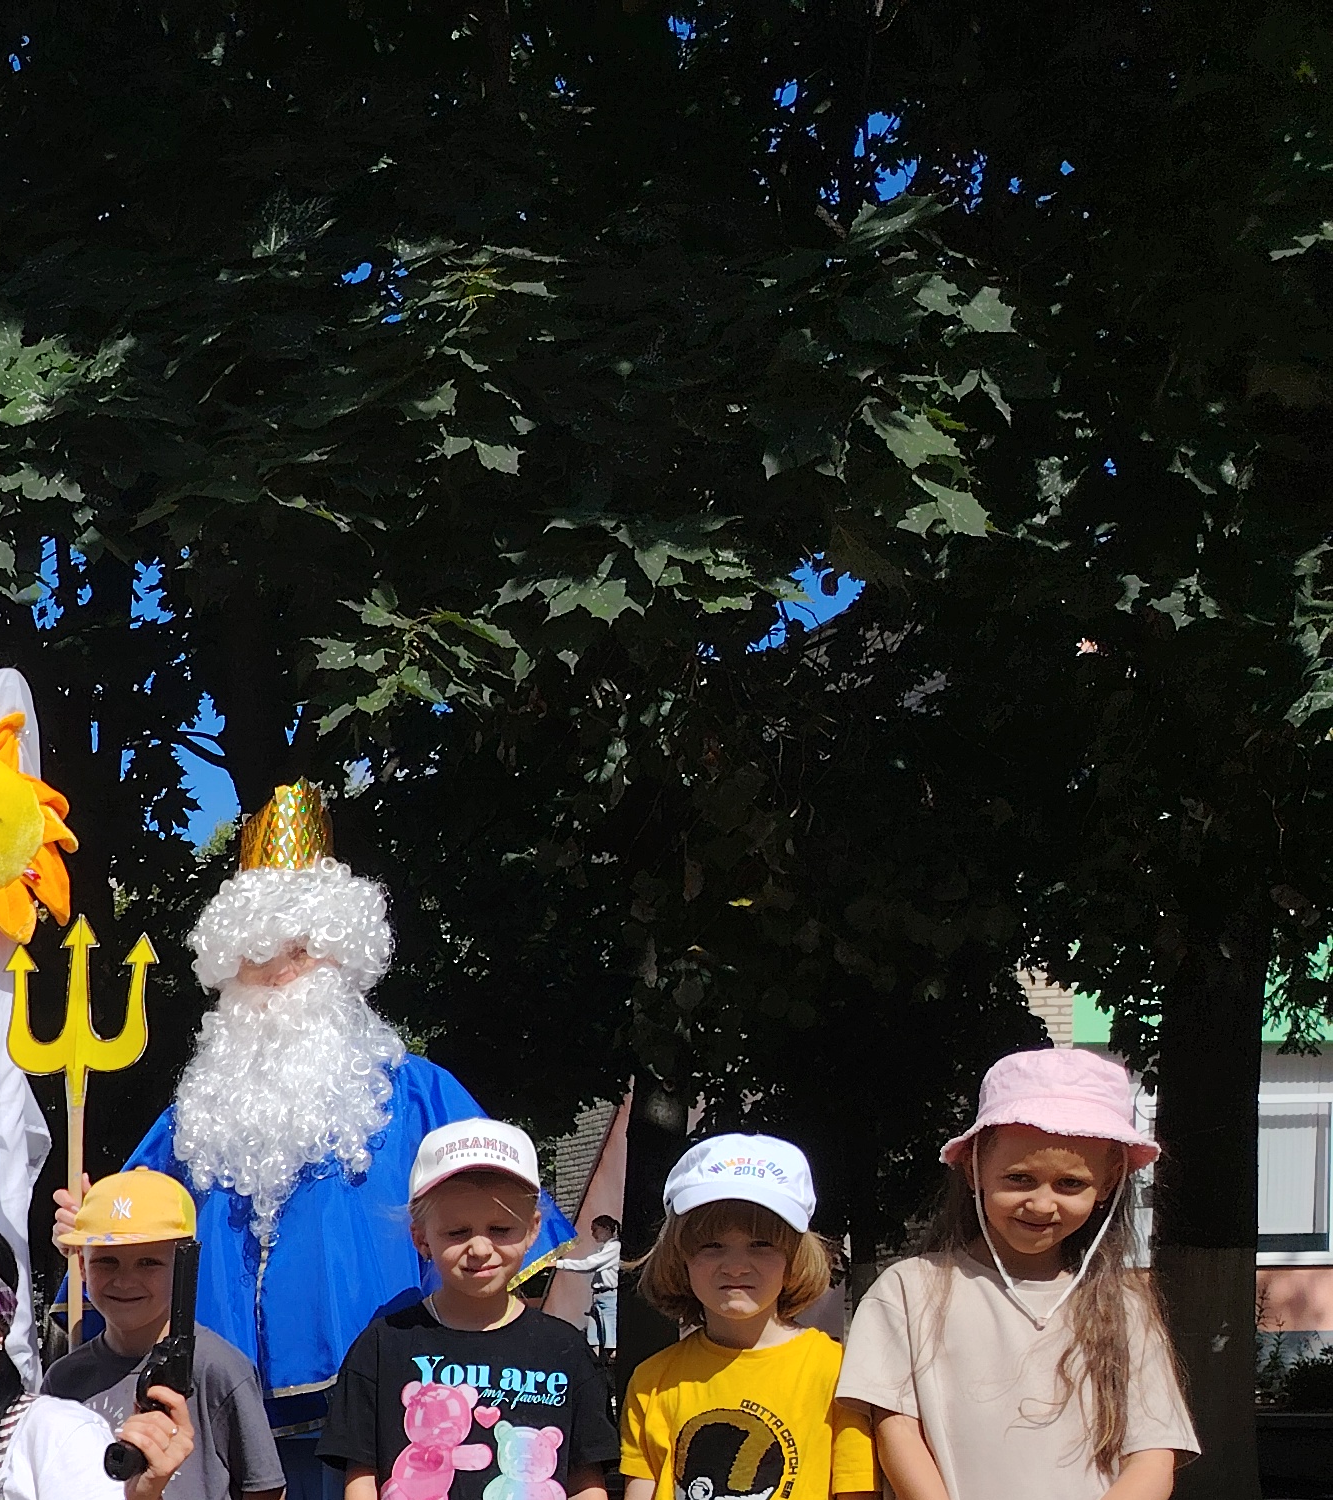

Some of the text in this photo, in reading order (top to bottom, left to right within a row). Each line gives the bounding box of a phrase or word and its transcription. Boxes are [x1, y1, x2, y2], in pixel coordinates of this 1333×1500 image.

[434, 1136, 520, 1165] DREAMER
[708, 1157, 789, 1184] WIMBLEDON
[733, 1165, 766, 1179] 2019
[411, 1355, 568, 1395] You are
[477, 1382, 566, 1410] my favorite
[740, 1398, 785, 1431] GOTTA
[779, 1428, 799, 1475] CATCH
